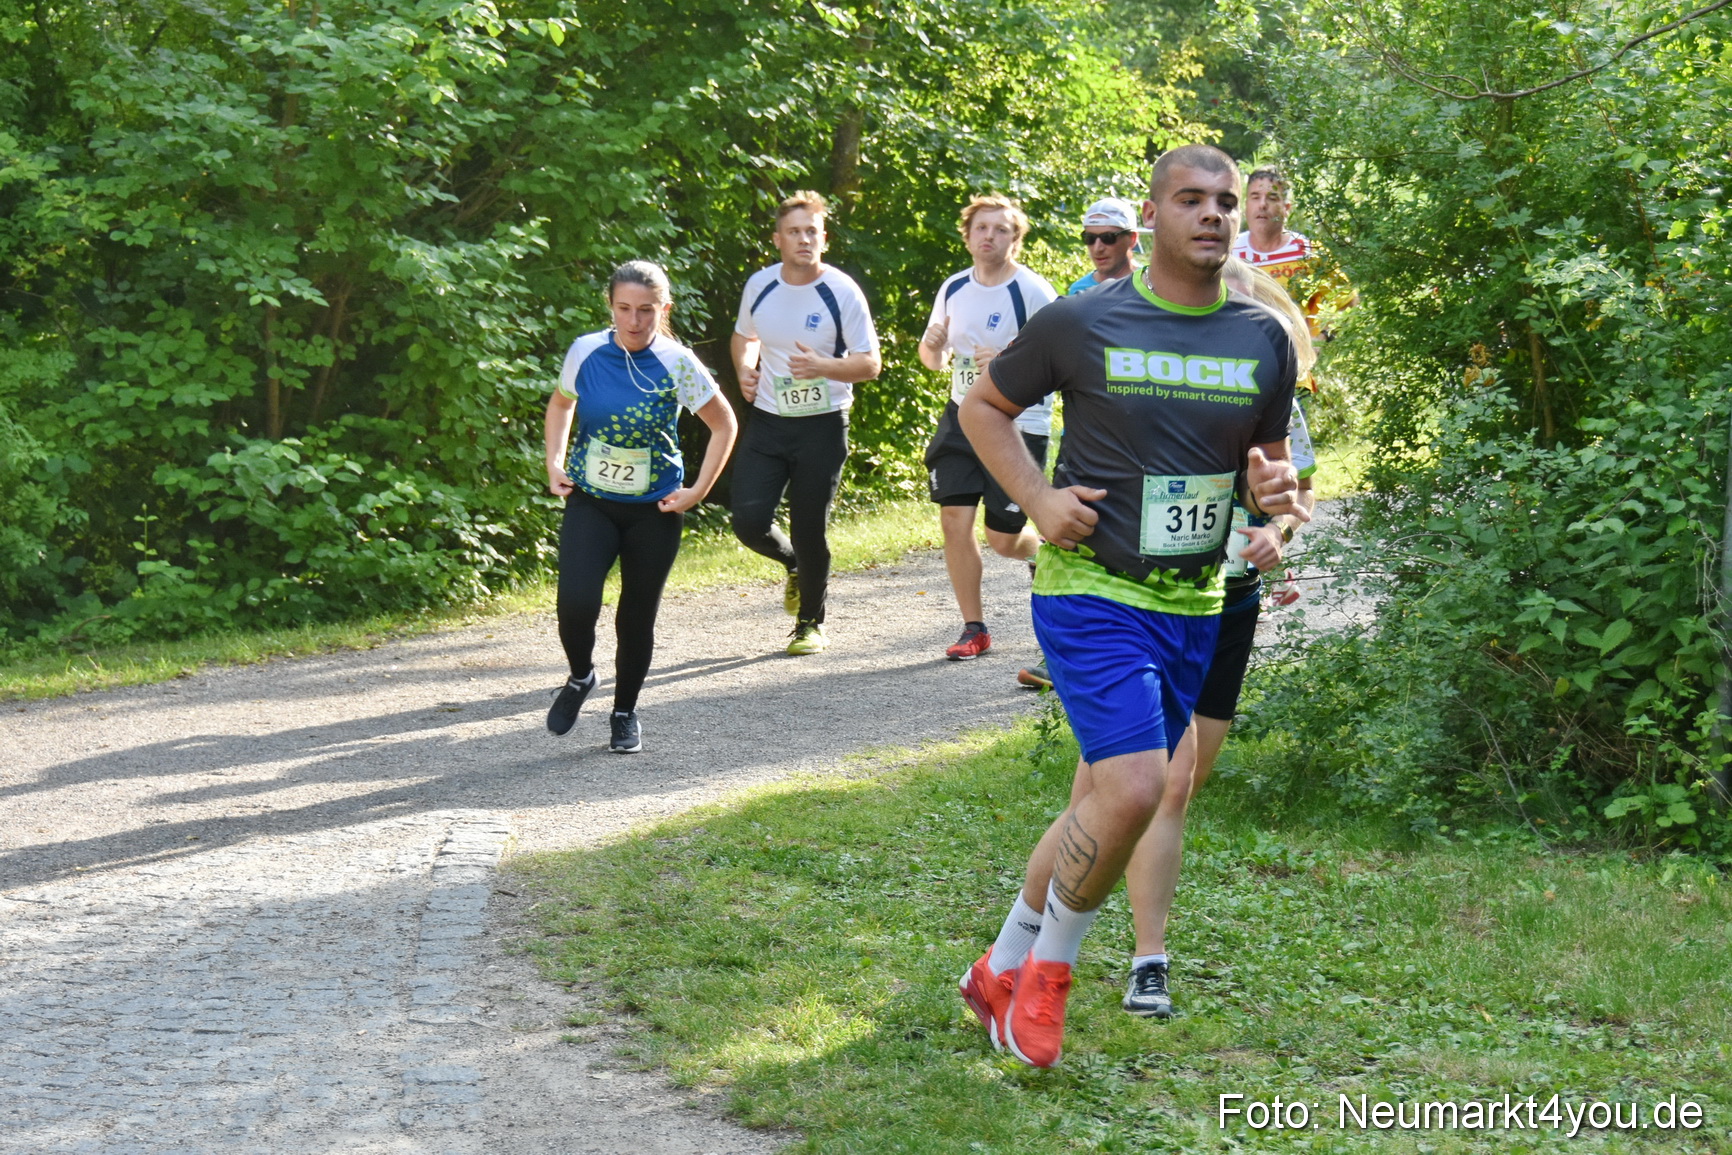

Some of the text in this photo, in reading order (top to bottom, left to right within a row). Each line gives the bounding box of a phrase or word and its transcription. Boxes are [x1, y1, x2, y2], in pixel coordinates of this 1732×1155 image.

[959, 370, 982, 385] 18
[1105, 348, 1259, 393] BOCK
[781, 386, 822, 405] 1873
[1106, 383, 1253, 407] inspired by smart concepts
[598, 460, 635, 481] 272
[1165, 503, 1218, 533] 315
